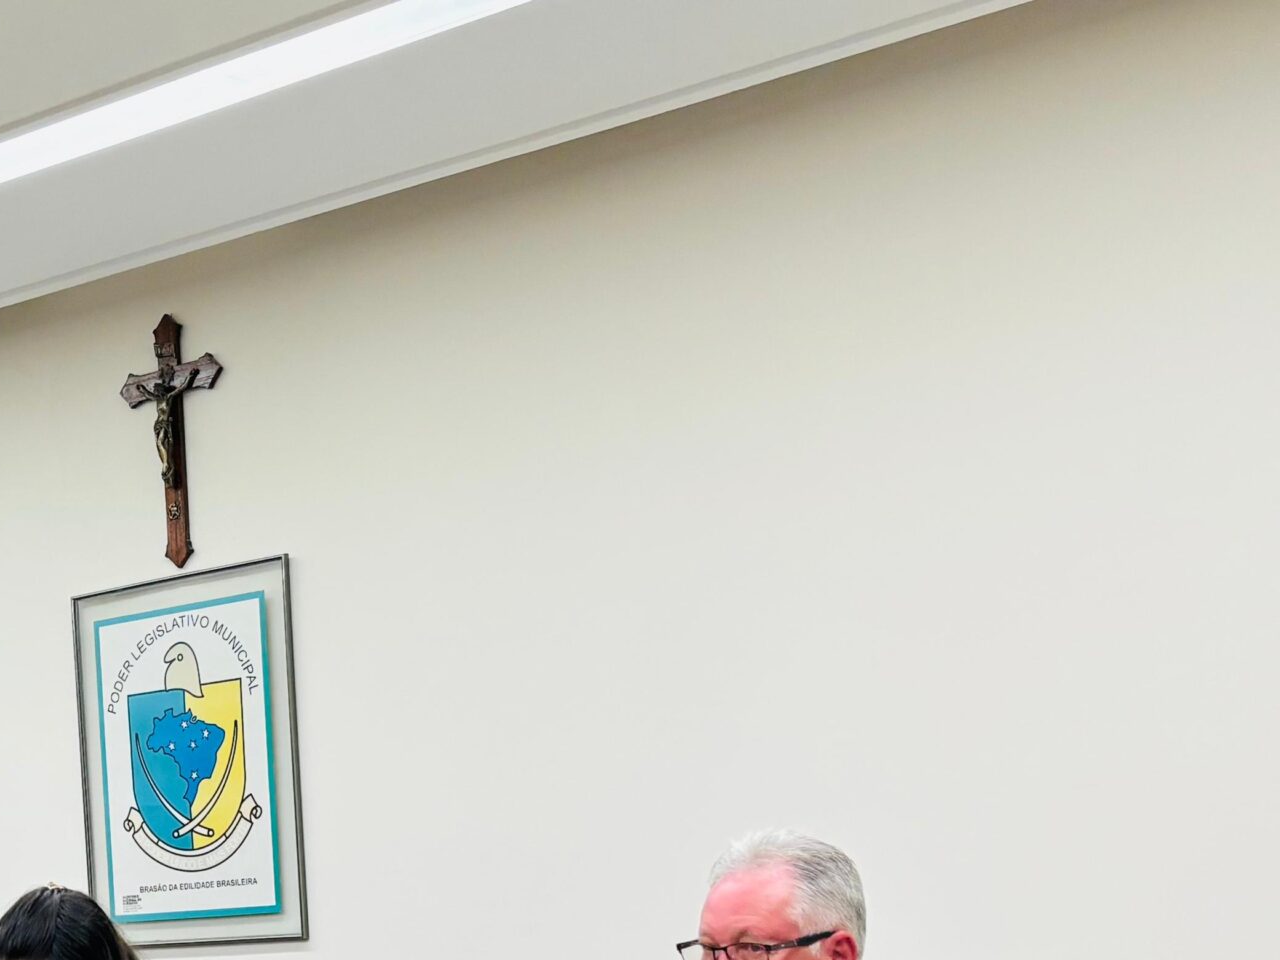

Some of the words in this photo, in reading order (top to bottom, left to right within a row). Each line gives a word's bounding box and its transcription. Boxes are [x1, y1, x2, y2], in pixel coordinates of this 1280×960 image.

[107, 660, 134, 714] PODER
[131, 614, 210, 661] LEGISLATIVO
[211, 620, 260, 695] MUNICIPAL
[169, 883, 178, 891] DA
[180, 880, 215, 890] EDILIDADE
[216, 877, 258, 888] BRASILEIRA
